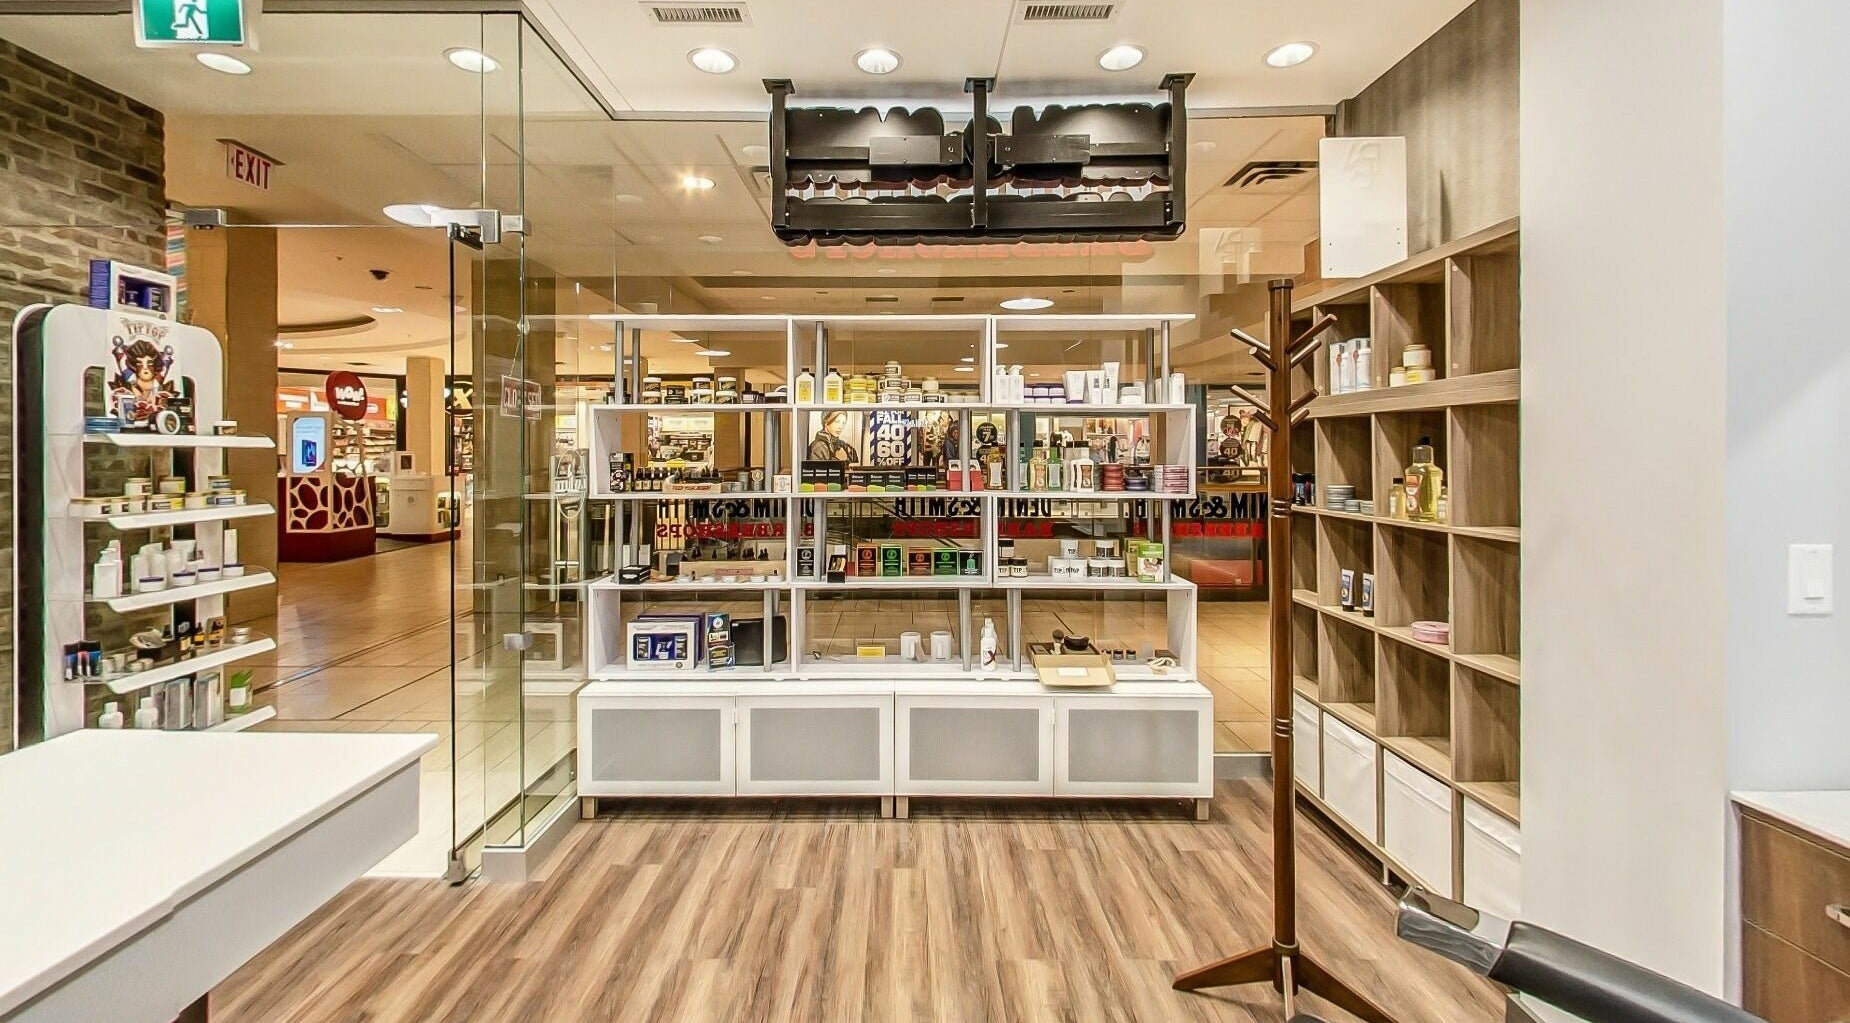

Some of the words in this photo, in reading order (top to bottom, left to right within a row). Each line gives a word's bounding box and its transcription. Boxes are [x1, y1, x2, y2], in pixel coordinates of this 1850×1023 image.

[235, 149, 271, 190] EXIT
[877, 424, 905, 441] 40
[877, 440, 905, 458] 60
[1223, 447, 1238, 456] 40
[877, 457, 905, 466] %OFF
